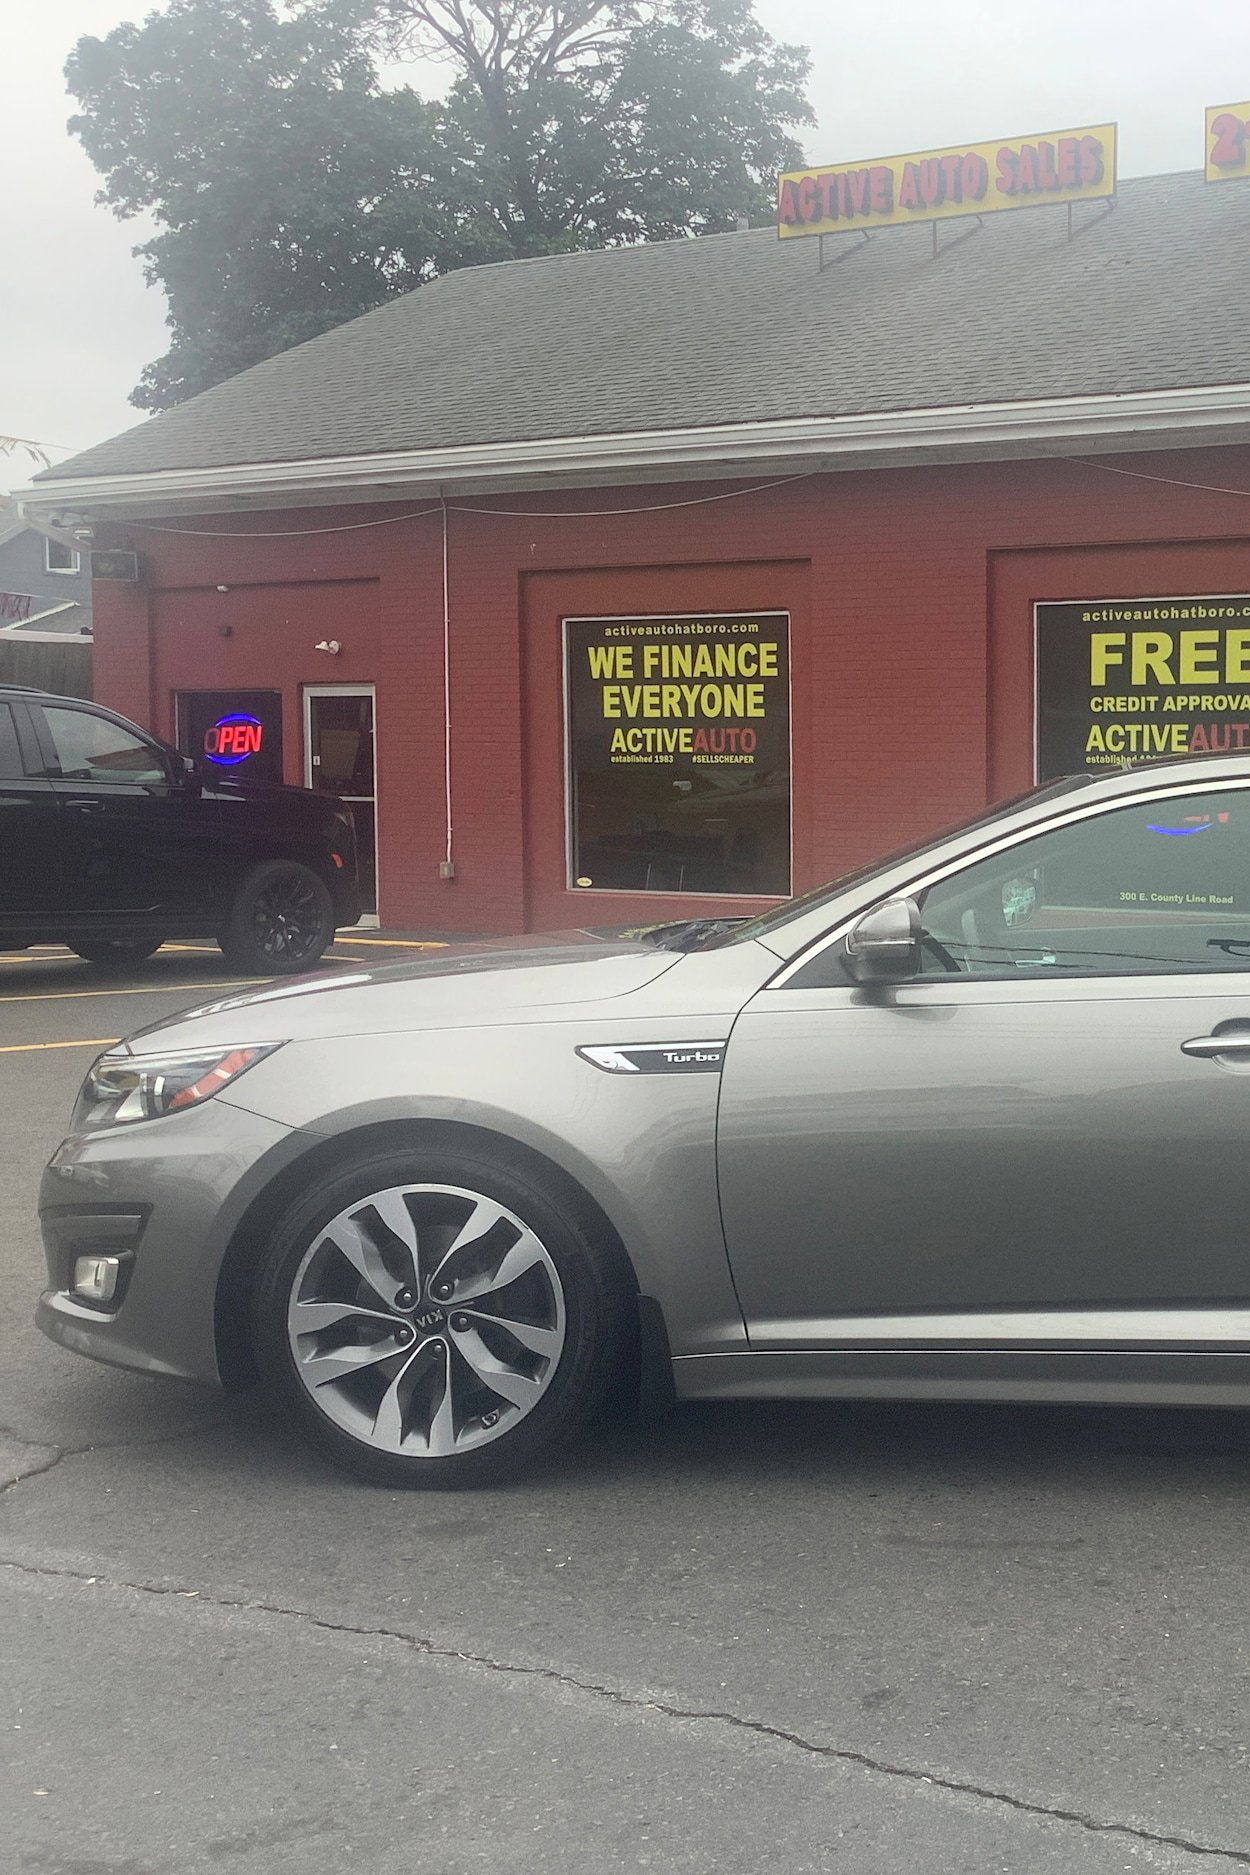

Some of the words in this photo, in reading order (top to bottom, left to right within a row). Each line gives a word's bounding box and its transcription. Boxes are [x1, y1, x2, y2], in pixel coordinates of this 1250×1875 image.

[780, 166, 894, 225] ACTIVE
[899, 152, 988, 209] AUTO
[996, 135, 1105, 196] SALES
[604, 623, 760, 637] activeautohatboro.com
[588, 646, 634, 679] WE
[643, 643, 778, 678] FINANCE
[603, 684, 766, 718] EVERYONE
[1090, 696, 1159, 713] CREDIT
[204, 725, 262, 753] OPEN
[610, 728, 757, 753] ACTIVEAUTO
[611, 755, 653, 764] established
[654, 755, 674, 764] 1983
[692, 755, 755, 764] #SELLSCHEAPER
[1119, 891, 1137, 901] 300
[1139, 892, 1149, 901] E.
[1150, 892, 1183, 904] County
[1186, 893, 1207, 903] Line
[1209, 894, 1234, 904] Road
[663, 1052, 720, 1063] Turbo
